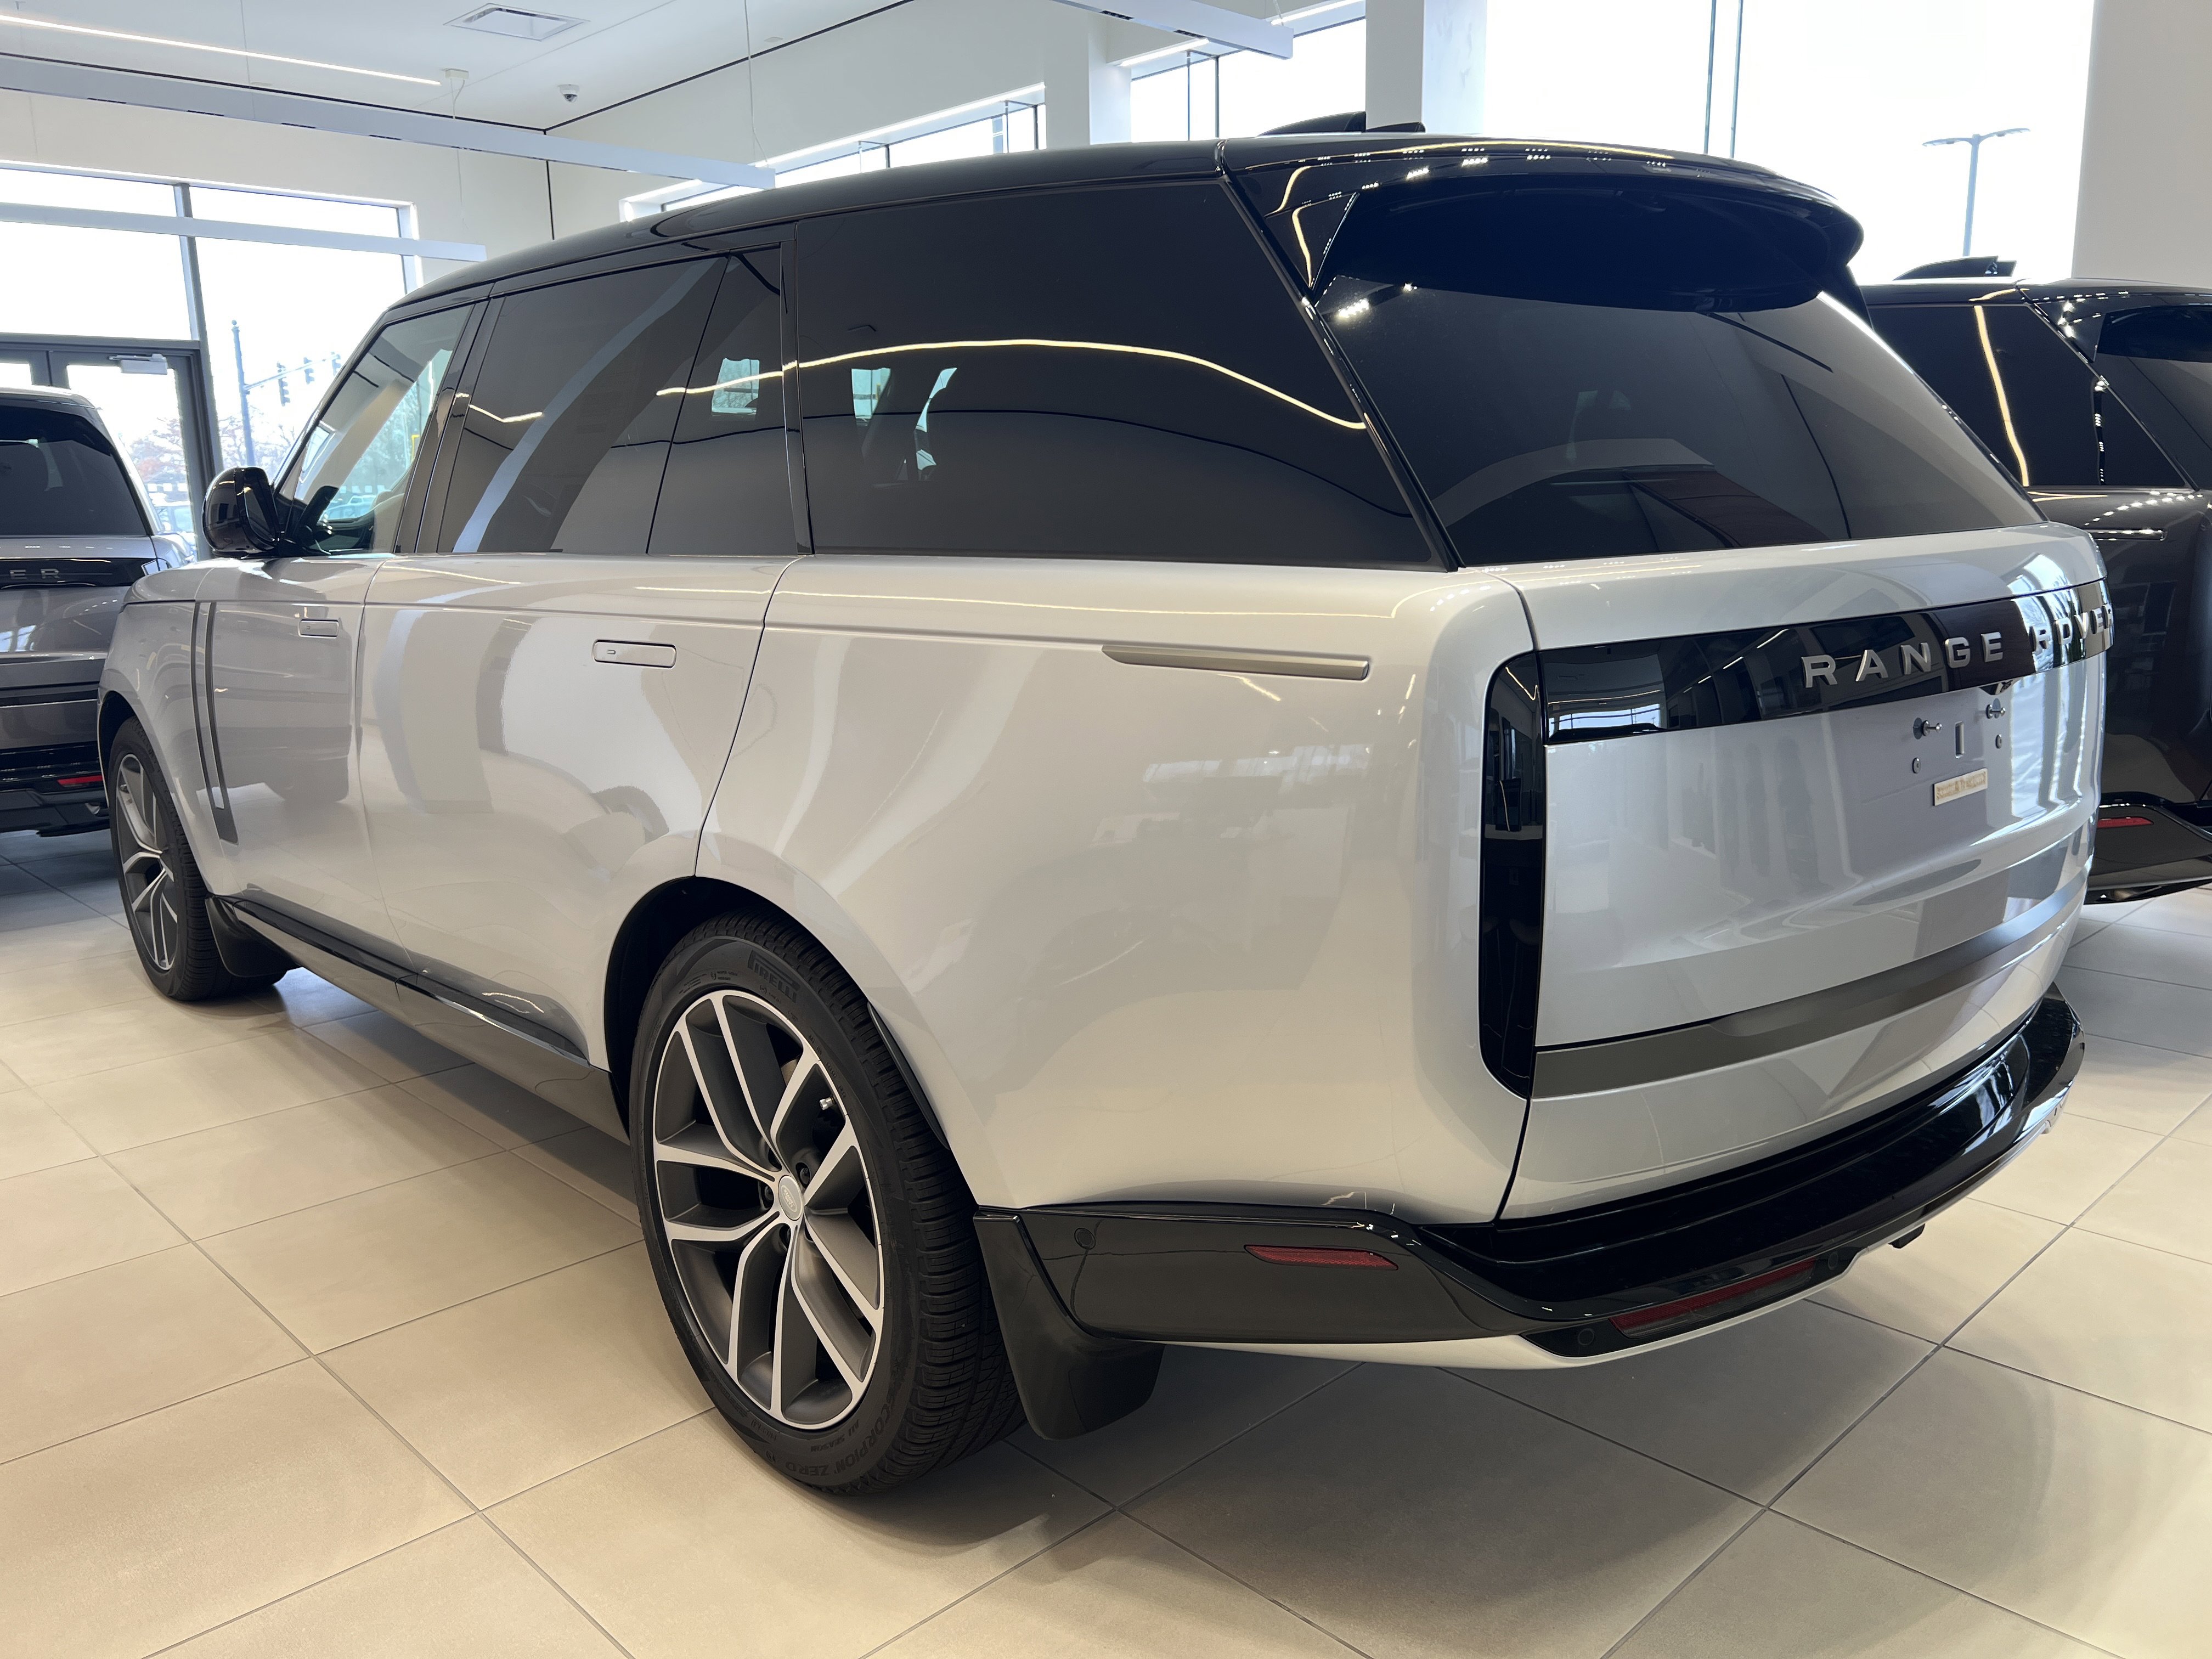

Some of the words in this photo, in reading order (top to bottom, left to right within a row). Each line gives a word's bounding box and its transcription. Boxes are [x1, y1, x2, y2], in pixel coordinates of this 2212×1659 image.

[1801, 632, 2004, 688] RANGE
[2029, 603, 2113, 652] ROVER
[747, 949, 800, 1003] PIRELLI
[835, 1392, 896, 1474] SCORPION
[785, 1461, 830, 1476] ZERO
